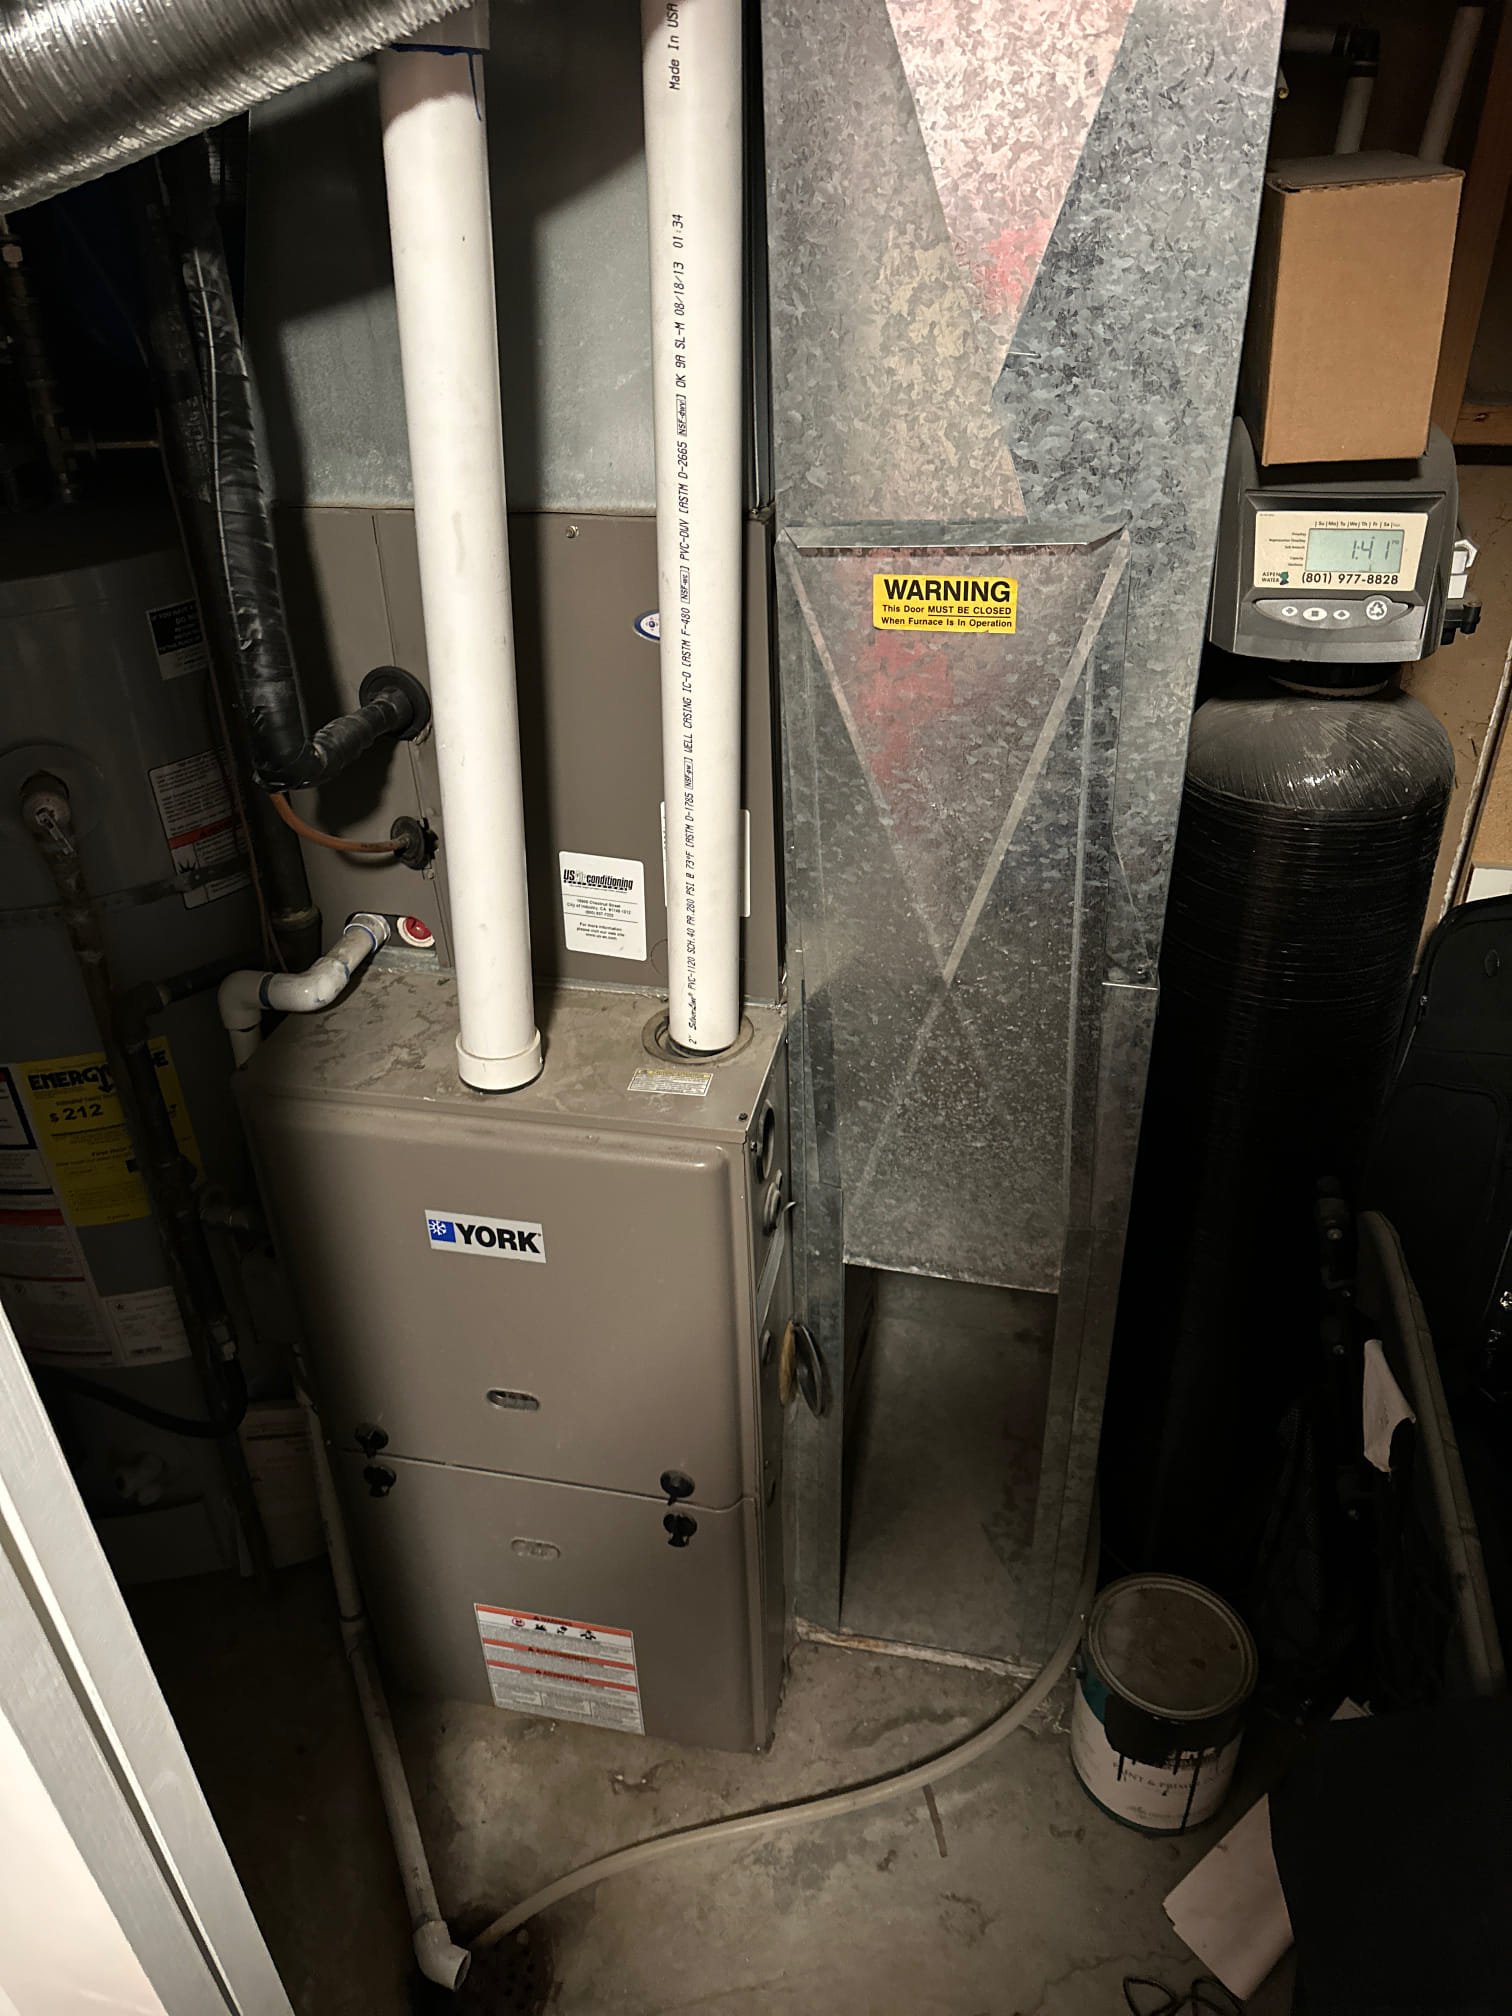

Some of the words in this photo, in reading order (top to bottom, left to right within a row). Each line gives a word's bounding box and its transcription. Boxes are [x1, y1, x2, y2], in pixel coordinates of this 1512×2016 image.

[667, 3, 679, 28] USA
[668, 35, 679, 51] In
[668, 59, 681, 90] Made
[672, 214, 684, 249] 01:34
[673, 262, 685, 316] 08/18/13
[675, 321, 686, 349] SL-M
[677, 441, 688, 479] D-2665
[884, 579, 1010, 602] WARNING
[1302, 572, 1332, 584] (801)
[1338, 574, 1398, 585] 977-8828
[681, 607, 691, 636] F-480
[882, 617, 905, 625] When
[908, 617, 943, 625] Furnace
[946, 618, 954, 626] Is
[969, 619, 1012, 628] Operation
[883, 605, 900, 613] This
[904, 605, 925, 613] Door
[928, 605, 954, 613] MUST
[958, 606, 969, 614] BE
[973, 606, 1011, 615] CLOSED
[682, 697, 692, 729] CASING
[684, 793, 694, 822] D-1785
[563, 868, 575, 881] US
[586, 873, 634, 891] conditioning
[686, 882, 694, 896] PSI
[687, 957, 696, 990] PVC-1120
[455, 1223, 540, 1254] YORK
